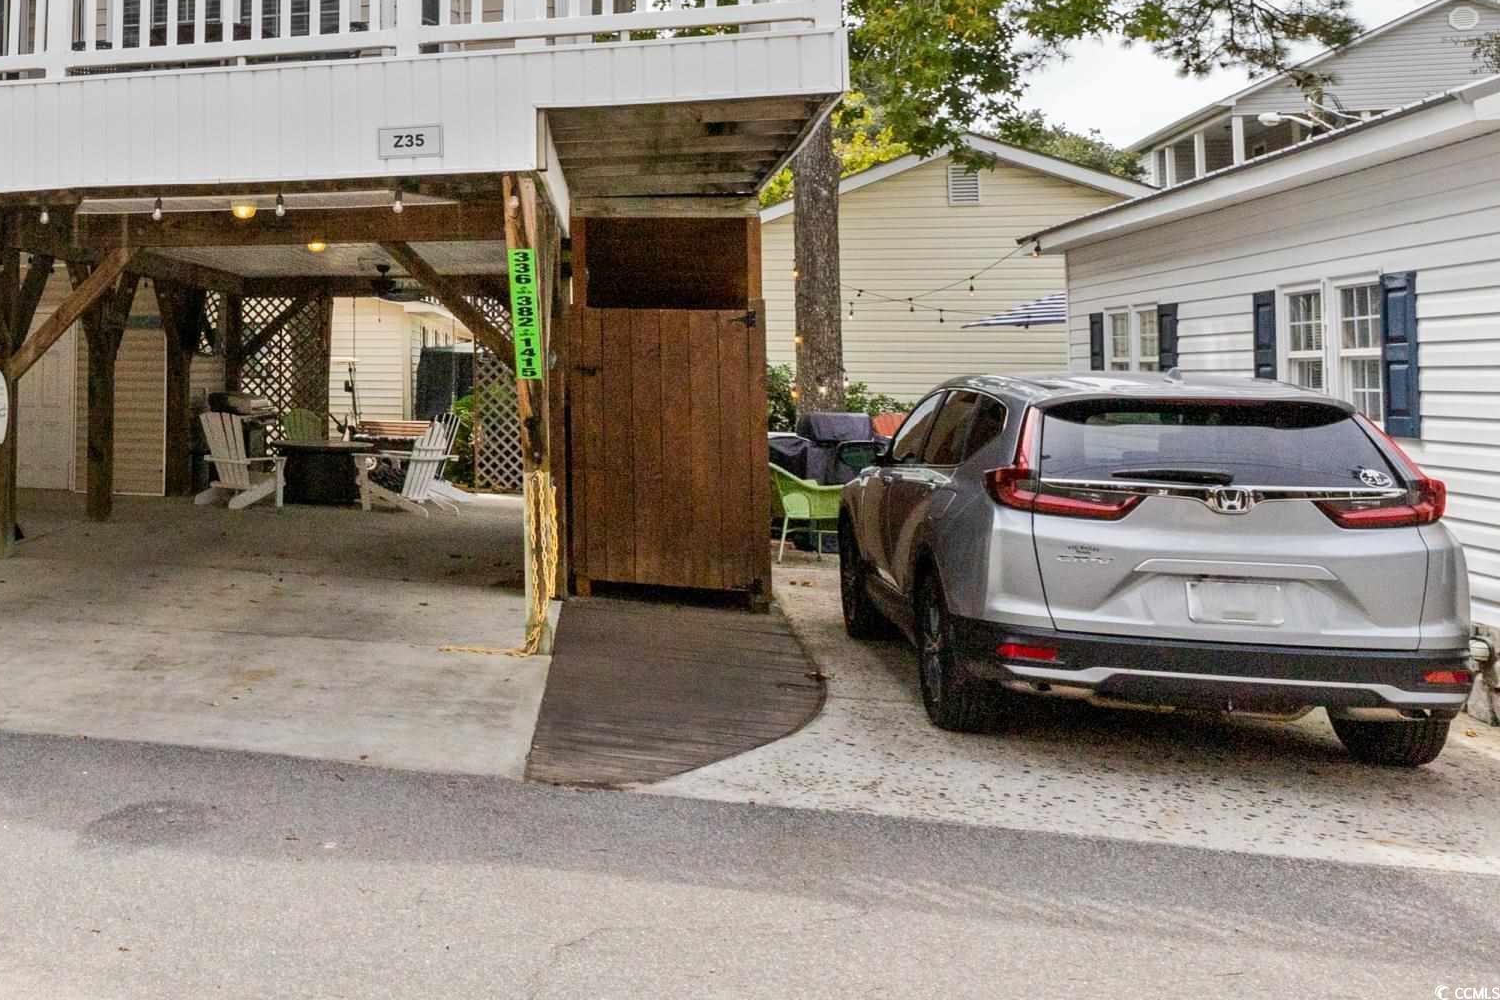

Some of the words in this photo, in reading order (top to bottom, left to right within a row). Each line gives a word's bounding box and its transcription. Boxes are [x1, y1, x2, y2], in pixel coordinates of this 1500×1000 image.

[393, 133, 425, 148] Z35
[514, 251, 532, 285] 336
[517, 295, 534, 328] 382
[519, 337, 537, 377] 1415
